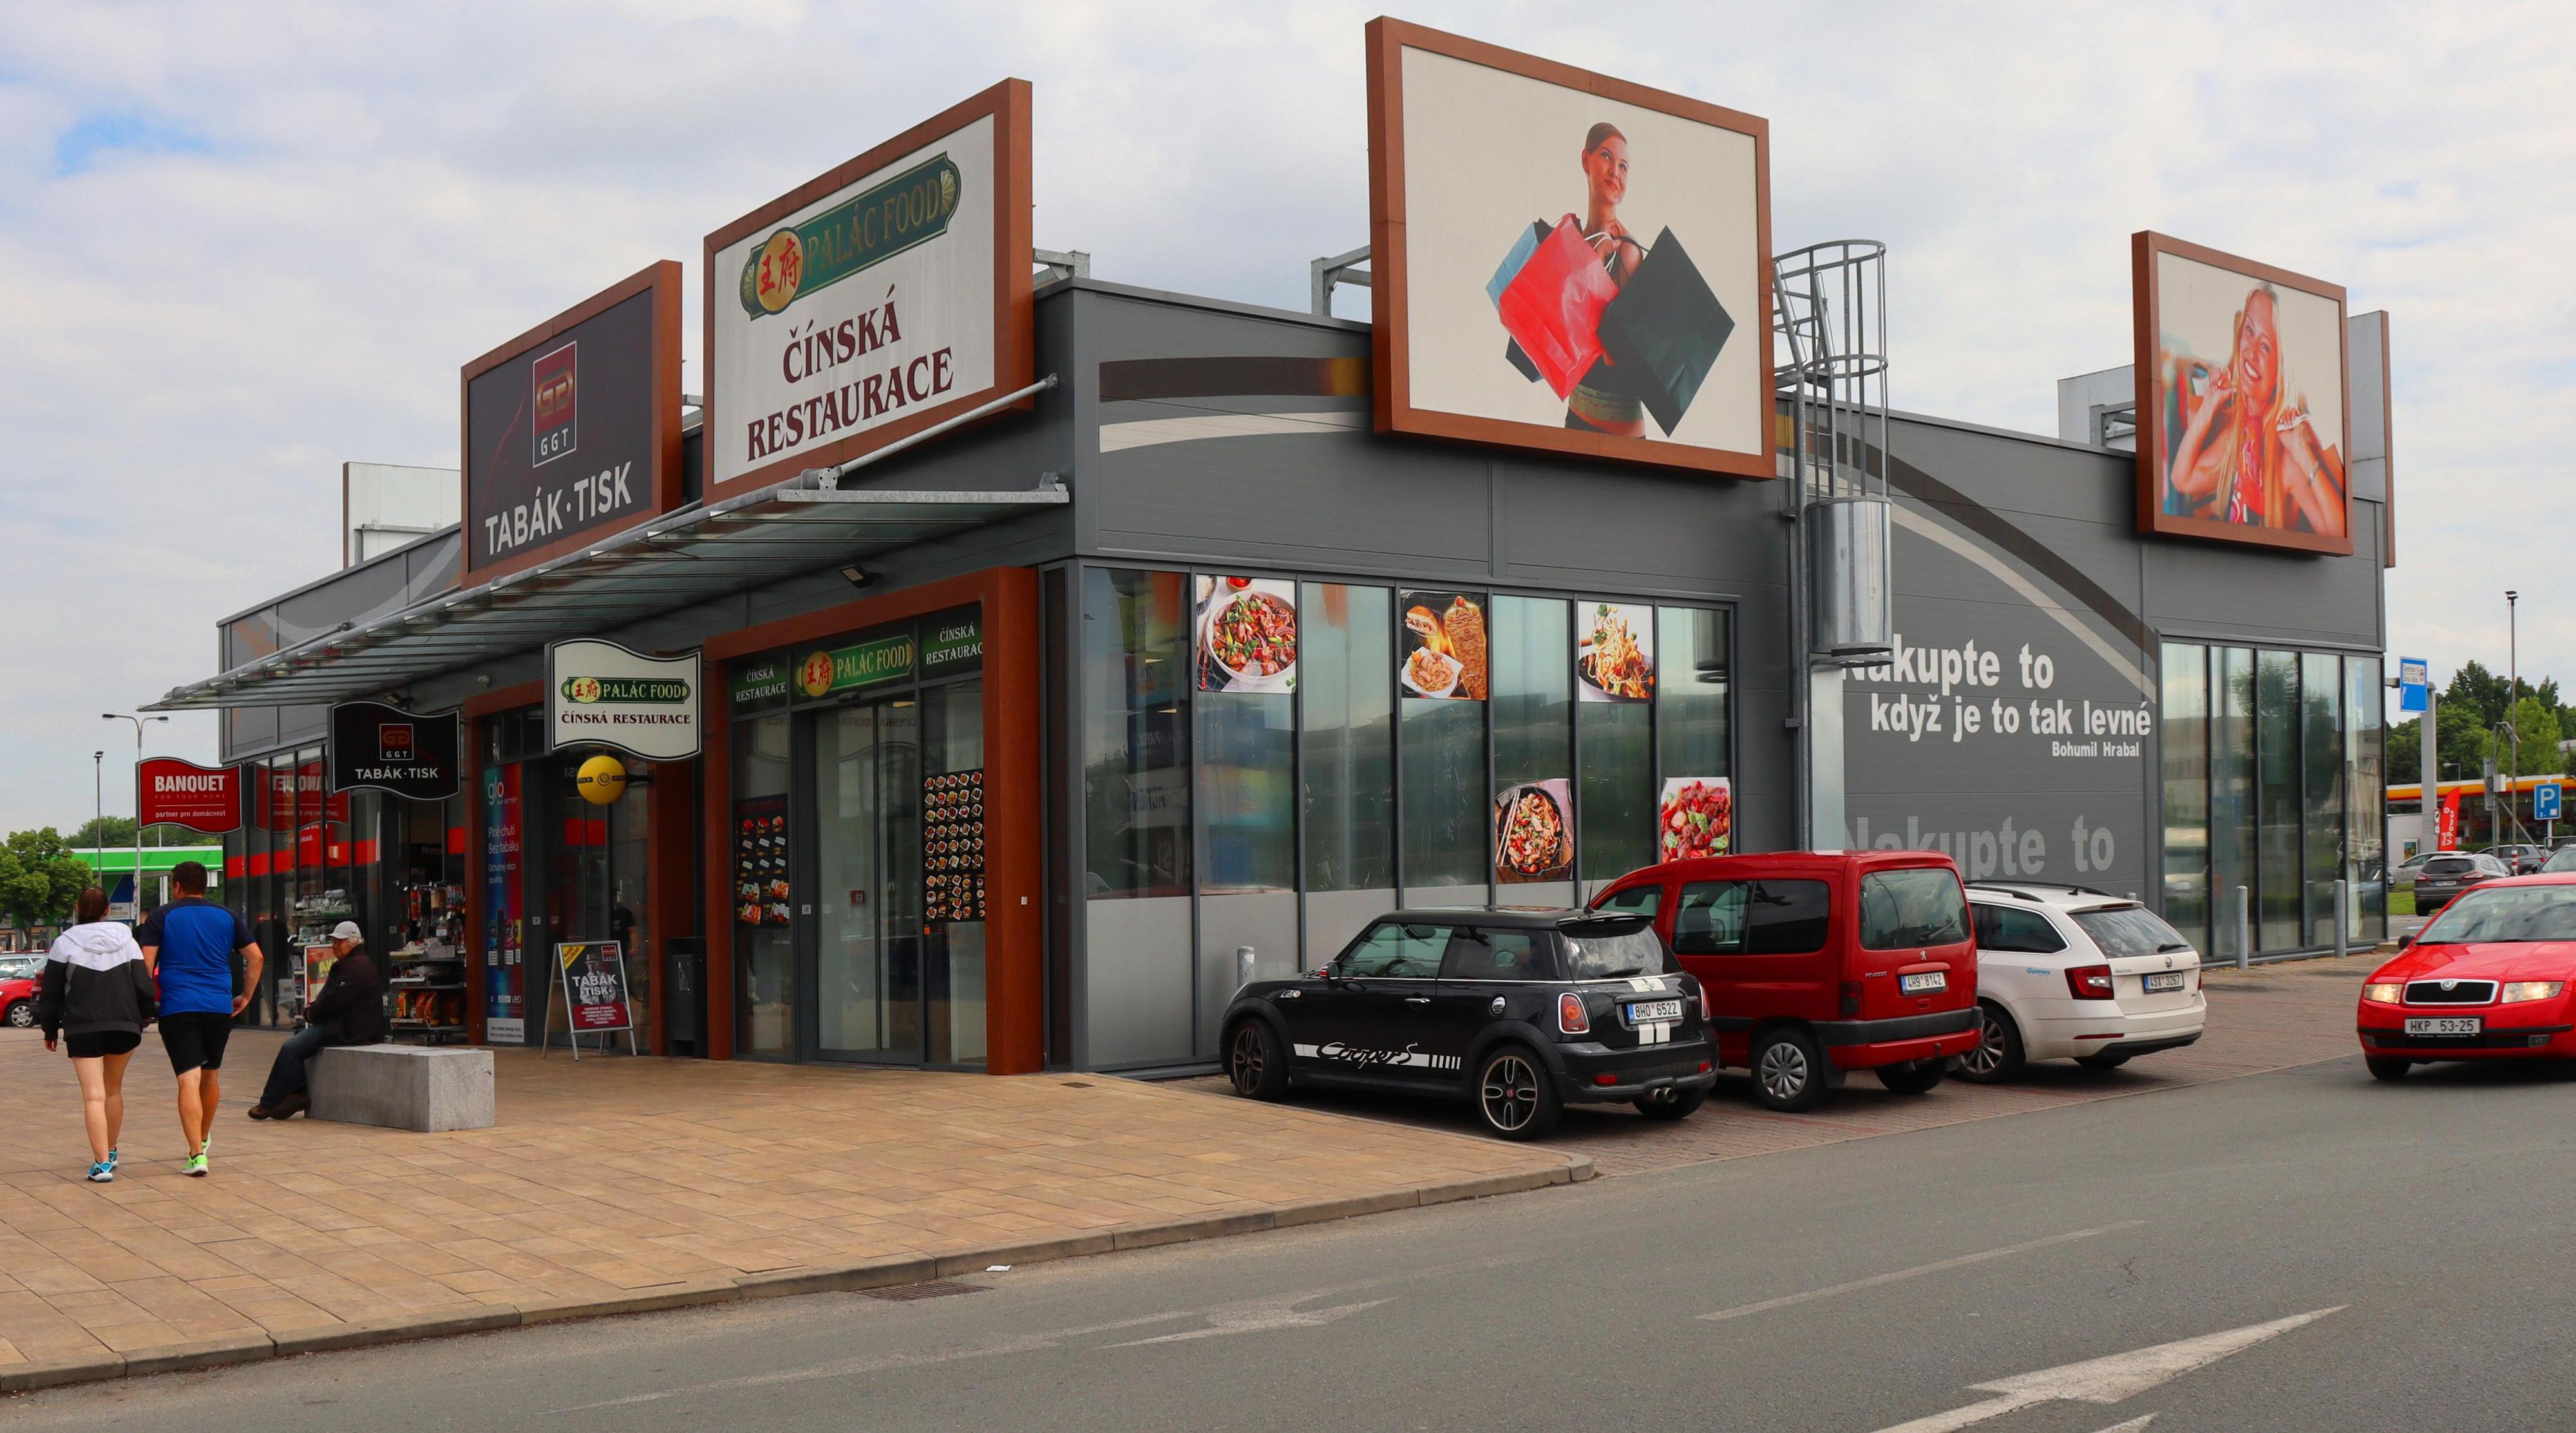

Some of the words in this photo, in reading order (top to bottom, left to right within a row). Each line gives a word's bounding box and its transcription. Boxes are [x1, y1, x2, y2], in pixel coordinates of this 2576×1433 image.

[808, 204, 876, 276] PALÁC
[884, 178, 942, 242] FOOD
[760, 238, 800, 296] 王府
[783, 283, 902, 384] ČÍNSKÁ
[748, 346, 954, 462] RESTAURACE
[540, 428, 569, 456] GGT
[940, 622, 975, 643] ČÍNSKÁ
[837, 649, 874, 679] PALÁC
[876, 645, 905, 670] FOOD
[926, 642, 983, 665] RESTAURAC
[746, 664, 775, 683] ČÍNSKÁ
[806, 656, 831, 687] 王府
[2019, 642, 2054, 690] to
[574, 679, 600, 699] 王府
[603, 681, 647, 699] PALÁC
[650, 685, 681, 699] FOOD
[736, 682, 786, 702] RESTAURACE
[561, 710, 608, 724] ČÍNSKÁ
[613, 714, 691, 725] RESTAURACE
[1871, 692, 1942, 742] když
[1953, 695, 1981, 743] je
[1992, 698, 2020, 735] to
[2029, 699, 2073, 735] tak
[2084, 700, 2152, 736] levné
[2052, 741, 2098, 757] Bohumil
[2103, 741, 2139, 757] Hrabal
[155, 775, 225, 793] BANQUET
[488, 776, 504, 806] glo
[2541, 788, 2555, 808] P
[488, 842, 498, 854] Bez
[500, 839, 520, 853] tabáku
[2072, 813, 2114, 873] to
[571, 972, 618, 987] TABÁK
[1908, 976, 1920, 988] 4H9
[1925, 974, 1942, 986] 8142
[2150, 973, 2163, 987] 4SX
[2164, 972, 2180, 986] 3267
[1635, 1003, 1651, 1018] 8H0
[1656, 1002, 1678, 1016] 6522
[2410, 1020, 2431, 1032] HKP
[2440, 1020, 2474, 1032] 53-25
[1317, 1041, 1401, 1070] Cooper
